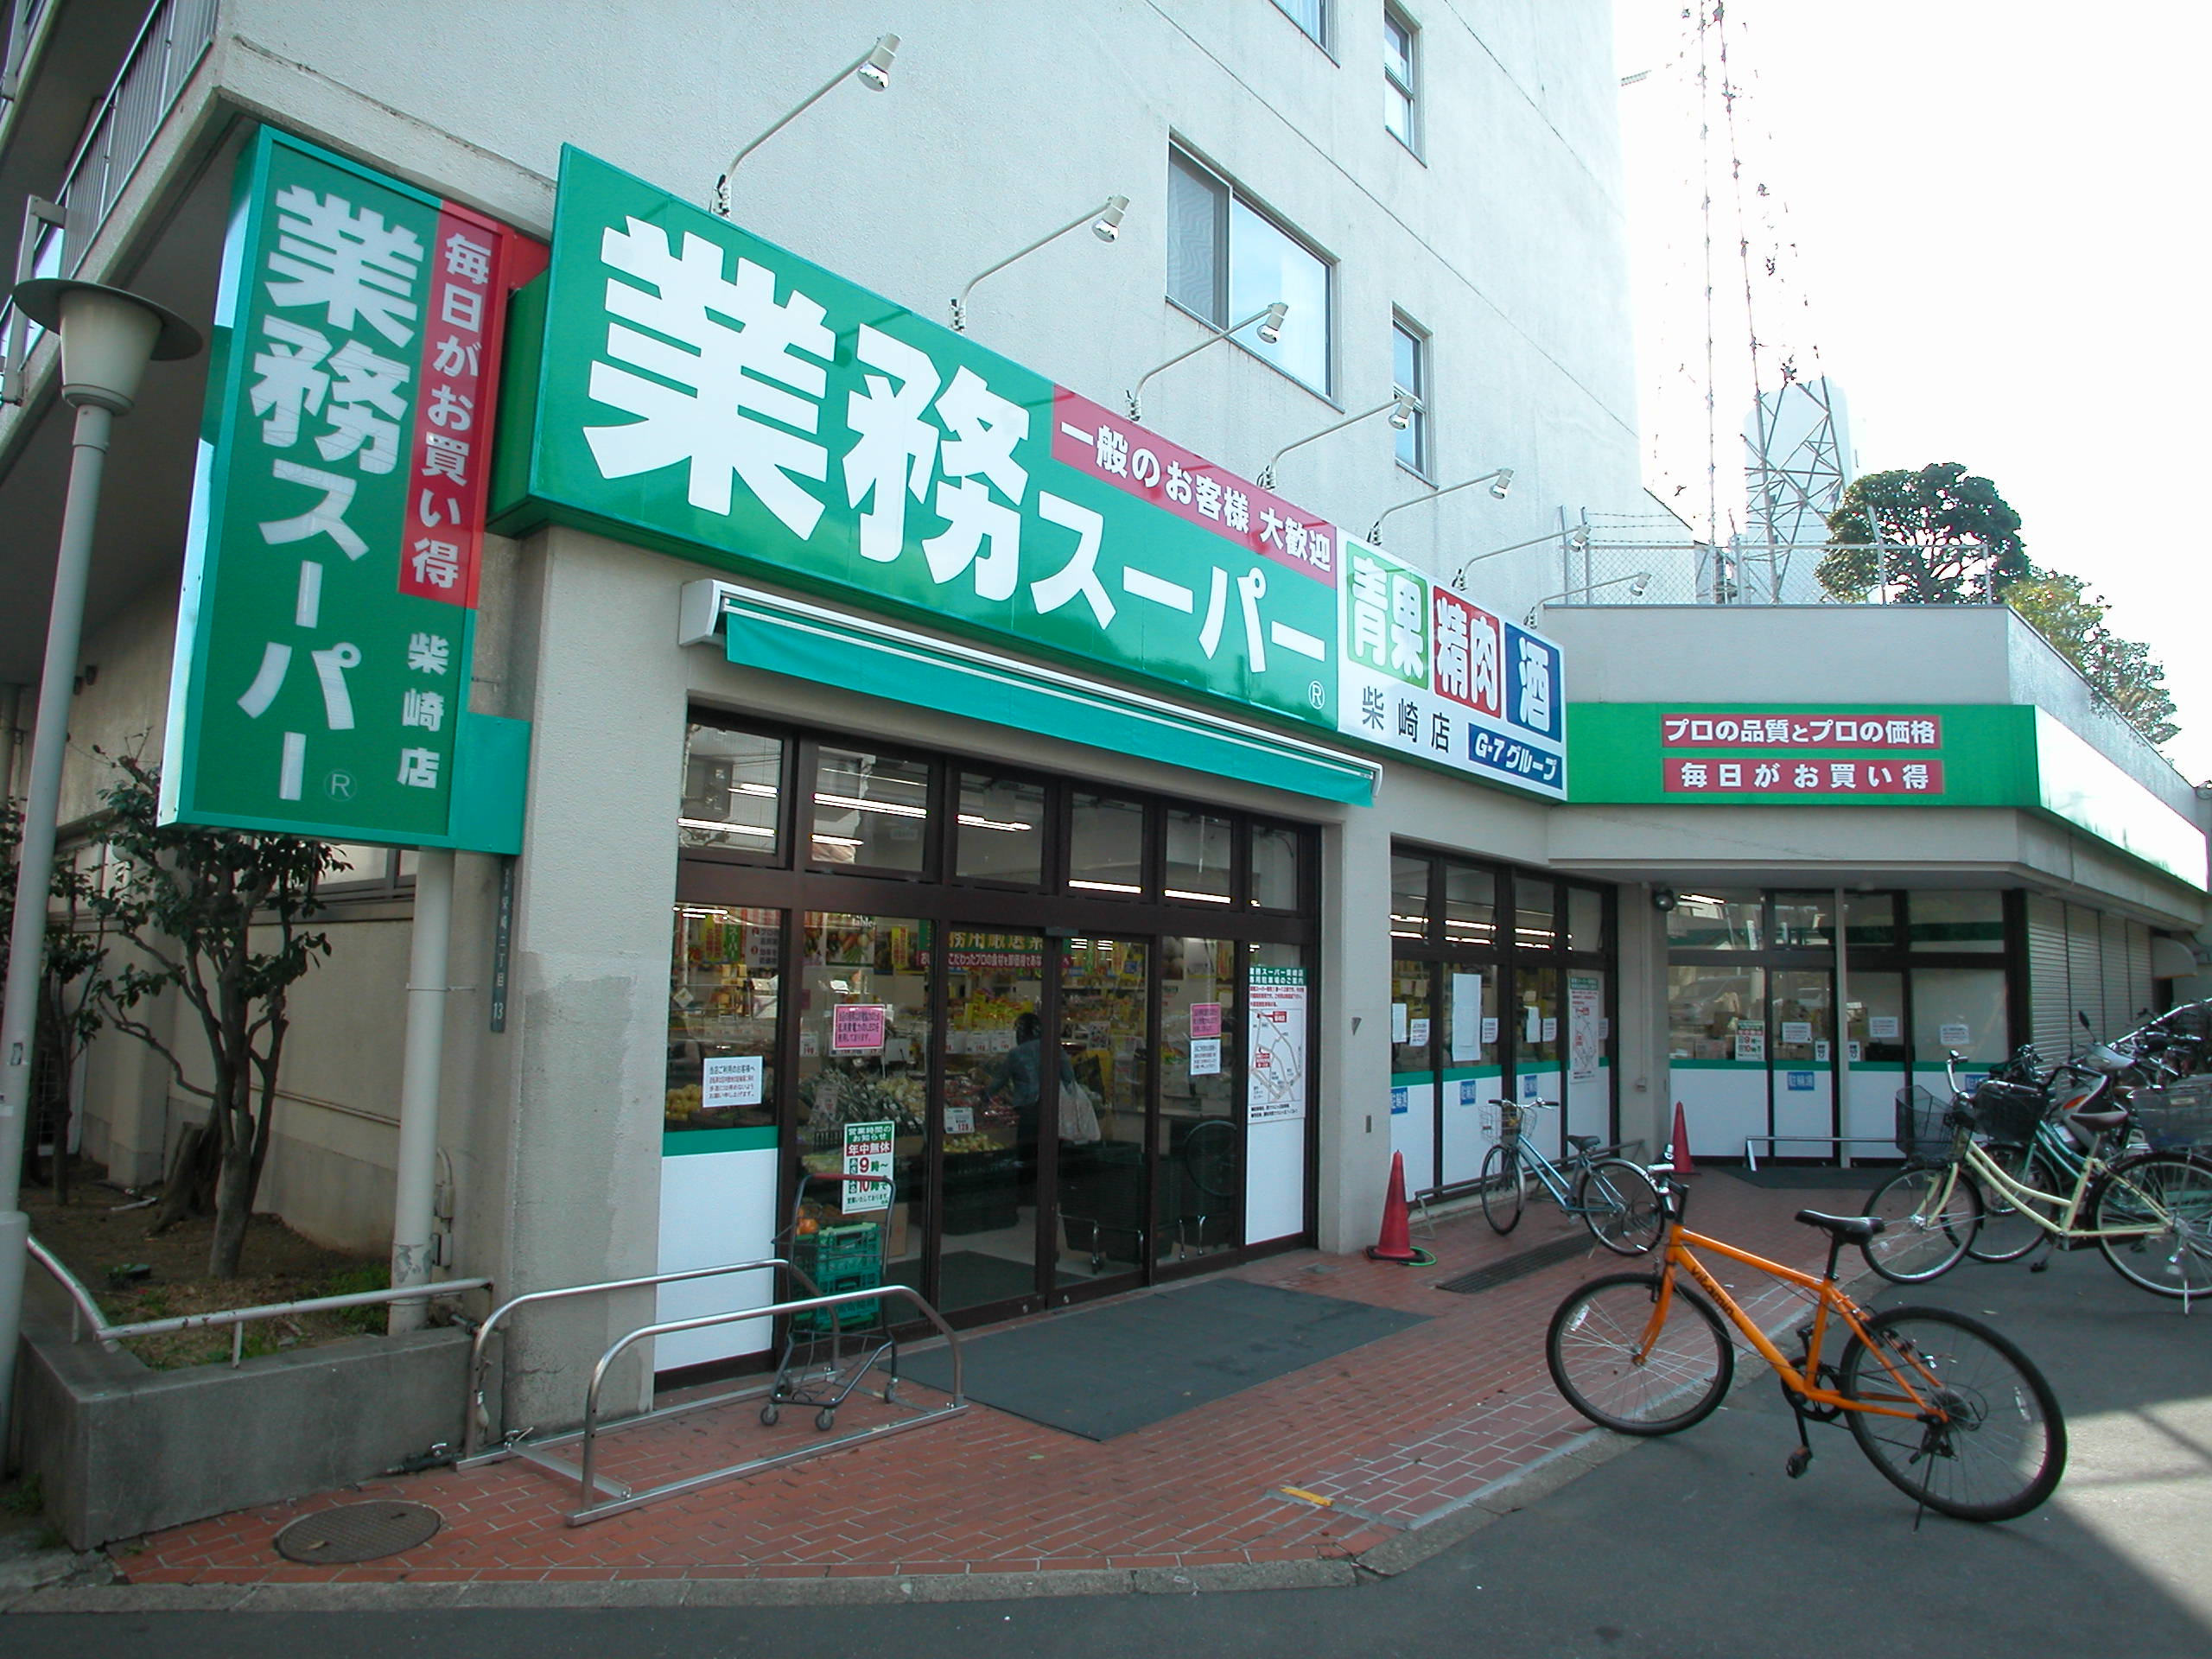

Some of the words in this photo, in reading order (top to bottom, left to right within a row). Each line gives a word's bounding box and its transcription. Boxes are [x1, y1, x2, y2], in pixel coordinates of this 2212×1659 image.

[411, 233, 491, 588] 毎日がお買い得
[582, 215, 1325, 673] 業務スーパー
[238, 184, 423, 801] 業務スーパー
[1352, 556, 1424, 680] 青果
[1436, 595, 1497, 711] 精肉
[397, 632, 450, 790] 柴崎店
[1362, 685, 1450, 753] 柴崎店
[1519, 636, 1551, 733] 酒
[1664, 719, 1936, 744] プロの品質とプロの価格
[1681, 762, 1929, 790] 毎日がお買い得
[848, 1126, 892, 1135] 営業時間の
[848, 1141, 890, 1155] 年中無休
[852, 1134, 887, 1142] お知らせ
